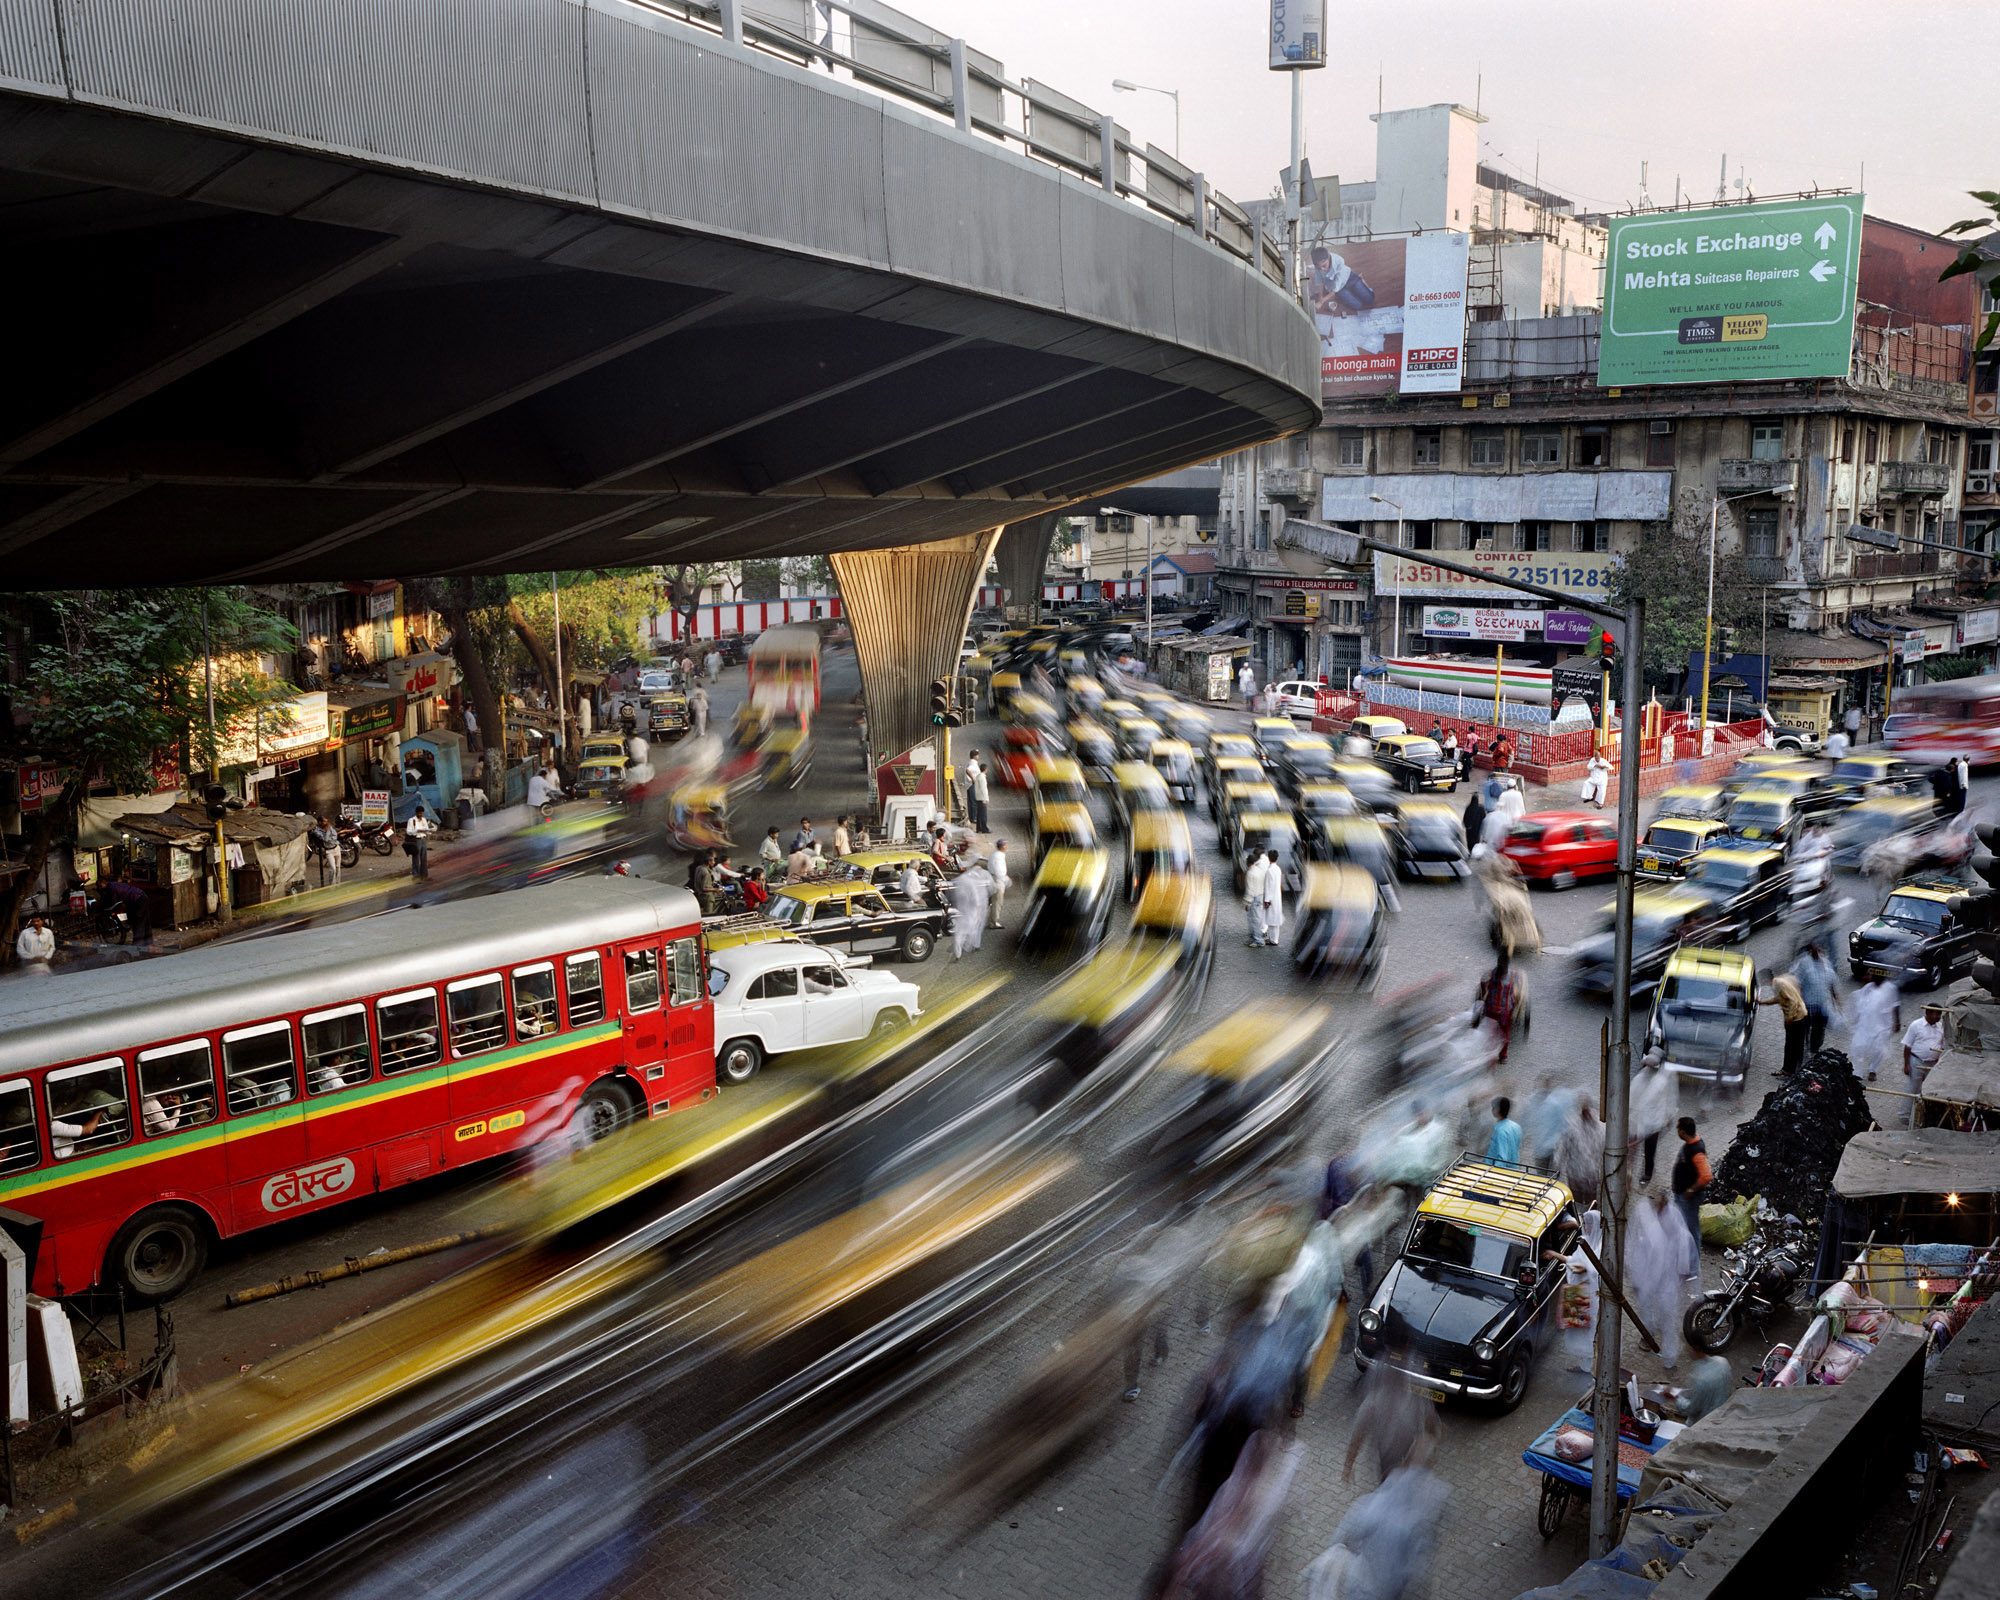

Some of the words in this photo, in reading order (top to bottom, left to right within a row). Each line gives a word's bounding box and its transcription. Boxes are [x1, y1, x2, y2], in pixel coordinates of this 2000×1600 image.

[1626, 238, 1688, 259] Stock
[1696, 231, 1802, 254] Exchange
[1624, 270, 1691, 290] Mehta
[1694, 271, 1742, 285] Suitcase
[1745, 268, 1800, 284] Repairers
[1425, 292, 1442, 301] 6663
[1443, 291, 1461, 300] 6000
[1668, 304, 1694, 314] WE'LL
[1696, 302, 1721, 312] MAKE
[1723, 301, 1742, 310] YOU
[1745, 299, 1784, 309] FAMOUS.
[1726, 319, 1764, 329] YELLOW
[1686, 328, 1716, 337] TIMES
[1730, 327, 1759, 336] PAGES
[1420, 350, 1455, 360] HDFC
[1333, 359, 1368, 372] loonga
[1370, 357, 1396, 368] main
[1409, 363, 1429, 371] HOME
[1432, 362, 1456, 370] LOANS
[1353, 374, 1373, 382] chance
[1374, 373, 1386, 382] kyon
[1474, 553, 1533, 562] CONTACT
[1291, 580, 1327, 589] TELEGRAPH
[1328, 581, 1354, 590] OFFICE
[1475, 616, 1539, 629] SZECHUAN
[1548, 619, 1567, 631] Hotel
[364, 792, 388, 800] NAAZ
[271, 1162, 346, 1208] बेस्ट
